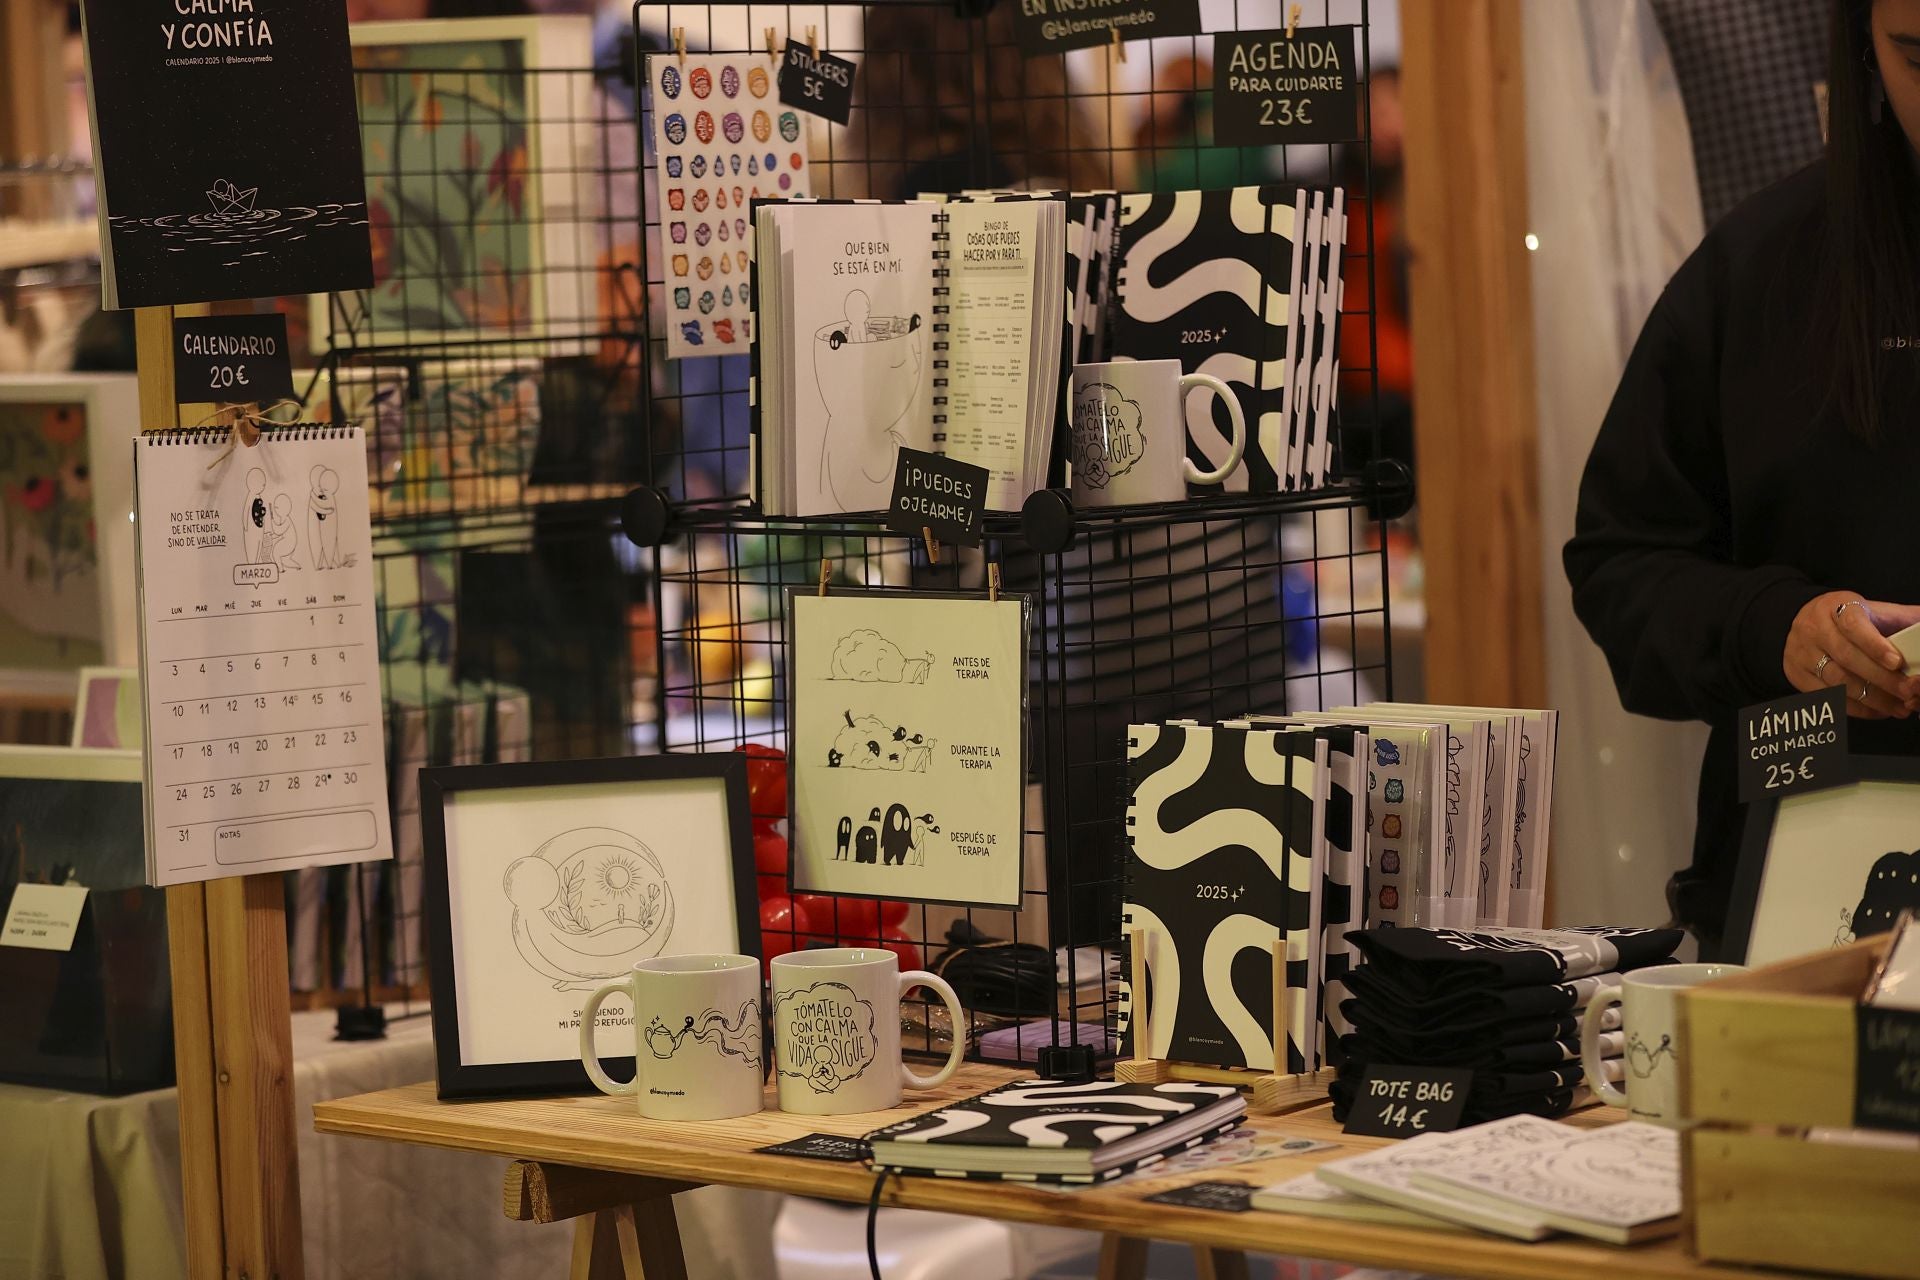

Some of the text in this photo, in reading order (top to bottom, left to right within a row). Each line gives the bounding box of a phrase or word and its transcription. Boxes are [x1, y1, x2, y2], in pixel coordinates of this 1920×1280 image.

[175, 0, 253, 15] CALMA
[161, 17, 273, 50] Y CONFÍA
[165, 57, 203, 66] CALENDARIO
[205, 56, 220, 65] 2025
[226, 54, 273, 65] @blancoymiedo
[1229, 41, 1340, 74] AGENDA
[790, 50, 849, 88] STICKERS
[803, 77, 824, 100] 5€
[1230, 76, 1343, 92] PARA CUIDARTE
[1259, 99, 1313, 126] 23€
[984, 221, 1009, 231] BINGO DE
[967, 231, 1020, 246] COSAS QUE PUEDES
[845, 241, 889, 257] QUE BIEN
[963, 248, 985, 262] HACER
[985, 249, 996, 261] POR
[996, 249, 1001, 260] Y
[1002, 248, 1015, 260] PARA
[833, 261, 844, 276] SE
[847, 258, 869, 275] ESTÁ
[873, 260, 886, 274] EN
[183, 333, 276, 356] CALENDARIO
[1181, 329, 1211, 344] 2025
[210, 365, 249, 388] 20€
[1089, 433, 1098, 442] LA
[1100, 433, 1137, 464] SIGUE
[905, 460, 972, 499] ¡PUEDES
[170, 509, 220, 522] NO SE TRATA
[900, 496, 973, 532] OJEARME!
[172, 525, 181, 535] DE
[167, 537, 185, 548] SINO
[186, 536, 196, 547] DE
[241, 569, 272, 579] MARZO
[171, 606, 183, 615] LUN
[195, 604, 208, 612] MAR
[225, 601, 236, 610] MIÉ
[250, 599, 262, 609] JUE
[278, 598, 288, 606] VIE
[333, 594, 346, 602] DOM
[309, 613, 344, 626] 1 2
[172, 651, 345, 676] 3 4 5 6 7 8 9
[952, 656, 991, 668] ANTES DE
[956, 669, 989, 681] TERAPIA
[172, 705, 184, 717] 10
[199, 703, 210, 715] 11
[227, 700, 238, 712] 12
[254, 697, 266, 709] 13
[311, 693, 324, 705] 15
[339, 690, 352, 703] 16
[1749, 701, 1835, 741] LÁMINA
[172, 731, 357, 760] 17 18 19 20 21 22 23
[951, 745, 1001, 758] DURANTE LA
[1750, 730, 1837, 760] CON MARCO
[960, 759, 993, 771] TERAPIA
[1764, 756, 1815, 789] 25€
[176, 772, 358, 801] 24 25 26 27 28 29 30
[178, 829, 190, 842] 31
[219, 830, 241, 839] NOTAS
[951, 830, 997, 845] DESPUÉS DE
[957, 845, 990, 857] TERAPIA
[1196, 884, 1229, 900] 2025
[794, 998, 852, 1020] TÓMATELO
[558, 1021, 569, 1029] MI
[791, 1018, 859, 1038] CON CALMA
[798, 1034, 829, 1046] QUE LA
[788, 1036, 867, 1067] VIDA SIGUE
[1370, 1079, 1454, 1102] TOTE BAG
[1378, 1103, 1429, 1129] 14€
